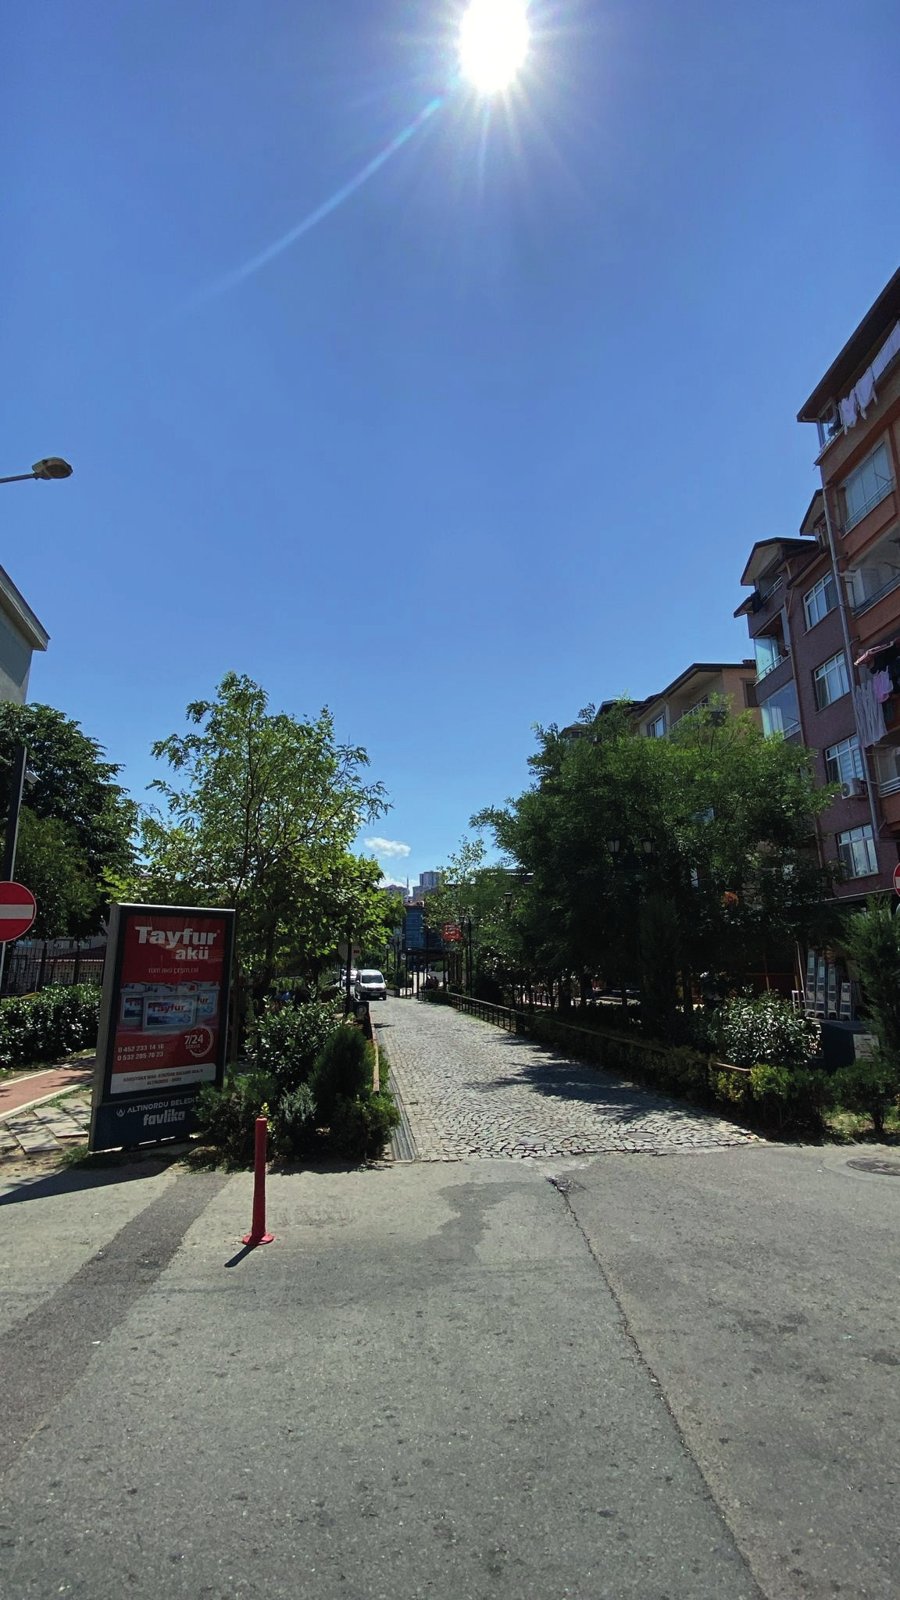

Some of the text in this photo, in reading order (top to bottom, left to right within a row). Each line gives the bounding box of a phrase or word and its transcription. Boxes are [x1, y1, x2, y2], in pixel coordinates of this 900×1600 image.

[134, 926, 217, 949] Tayfur
[175, 946, 209, 960] akü
[184, 1034, 204, 1045] 7/24
[127, 1101, 169, 1114] ALTINORDU
[143, 1108, 186, 1126] favlika
